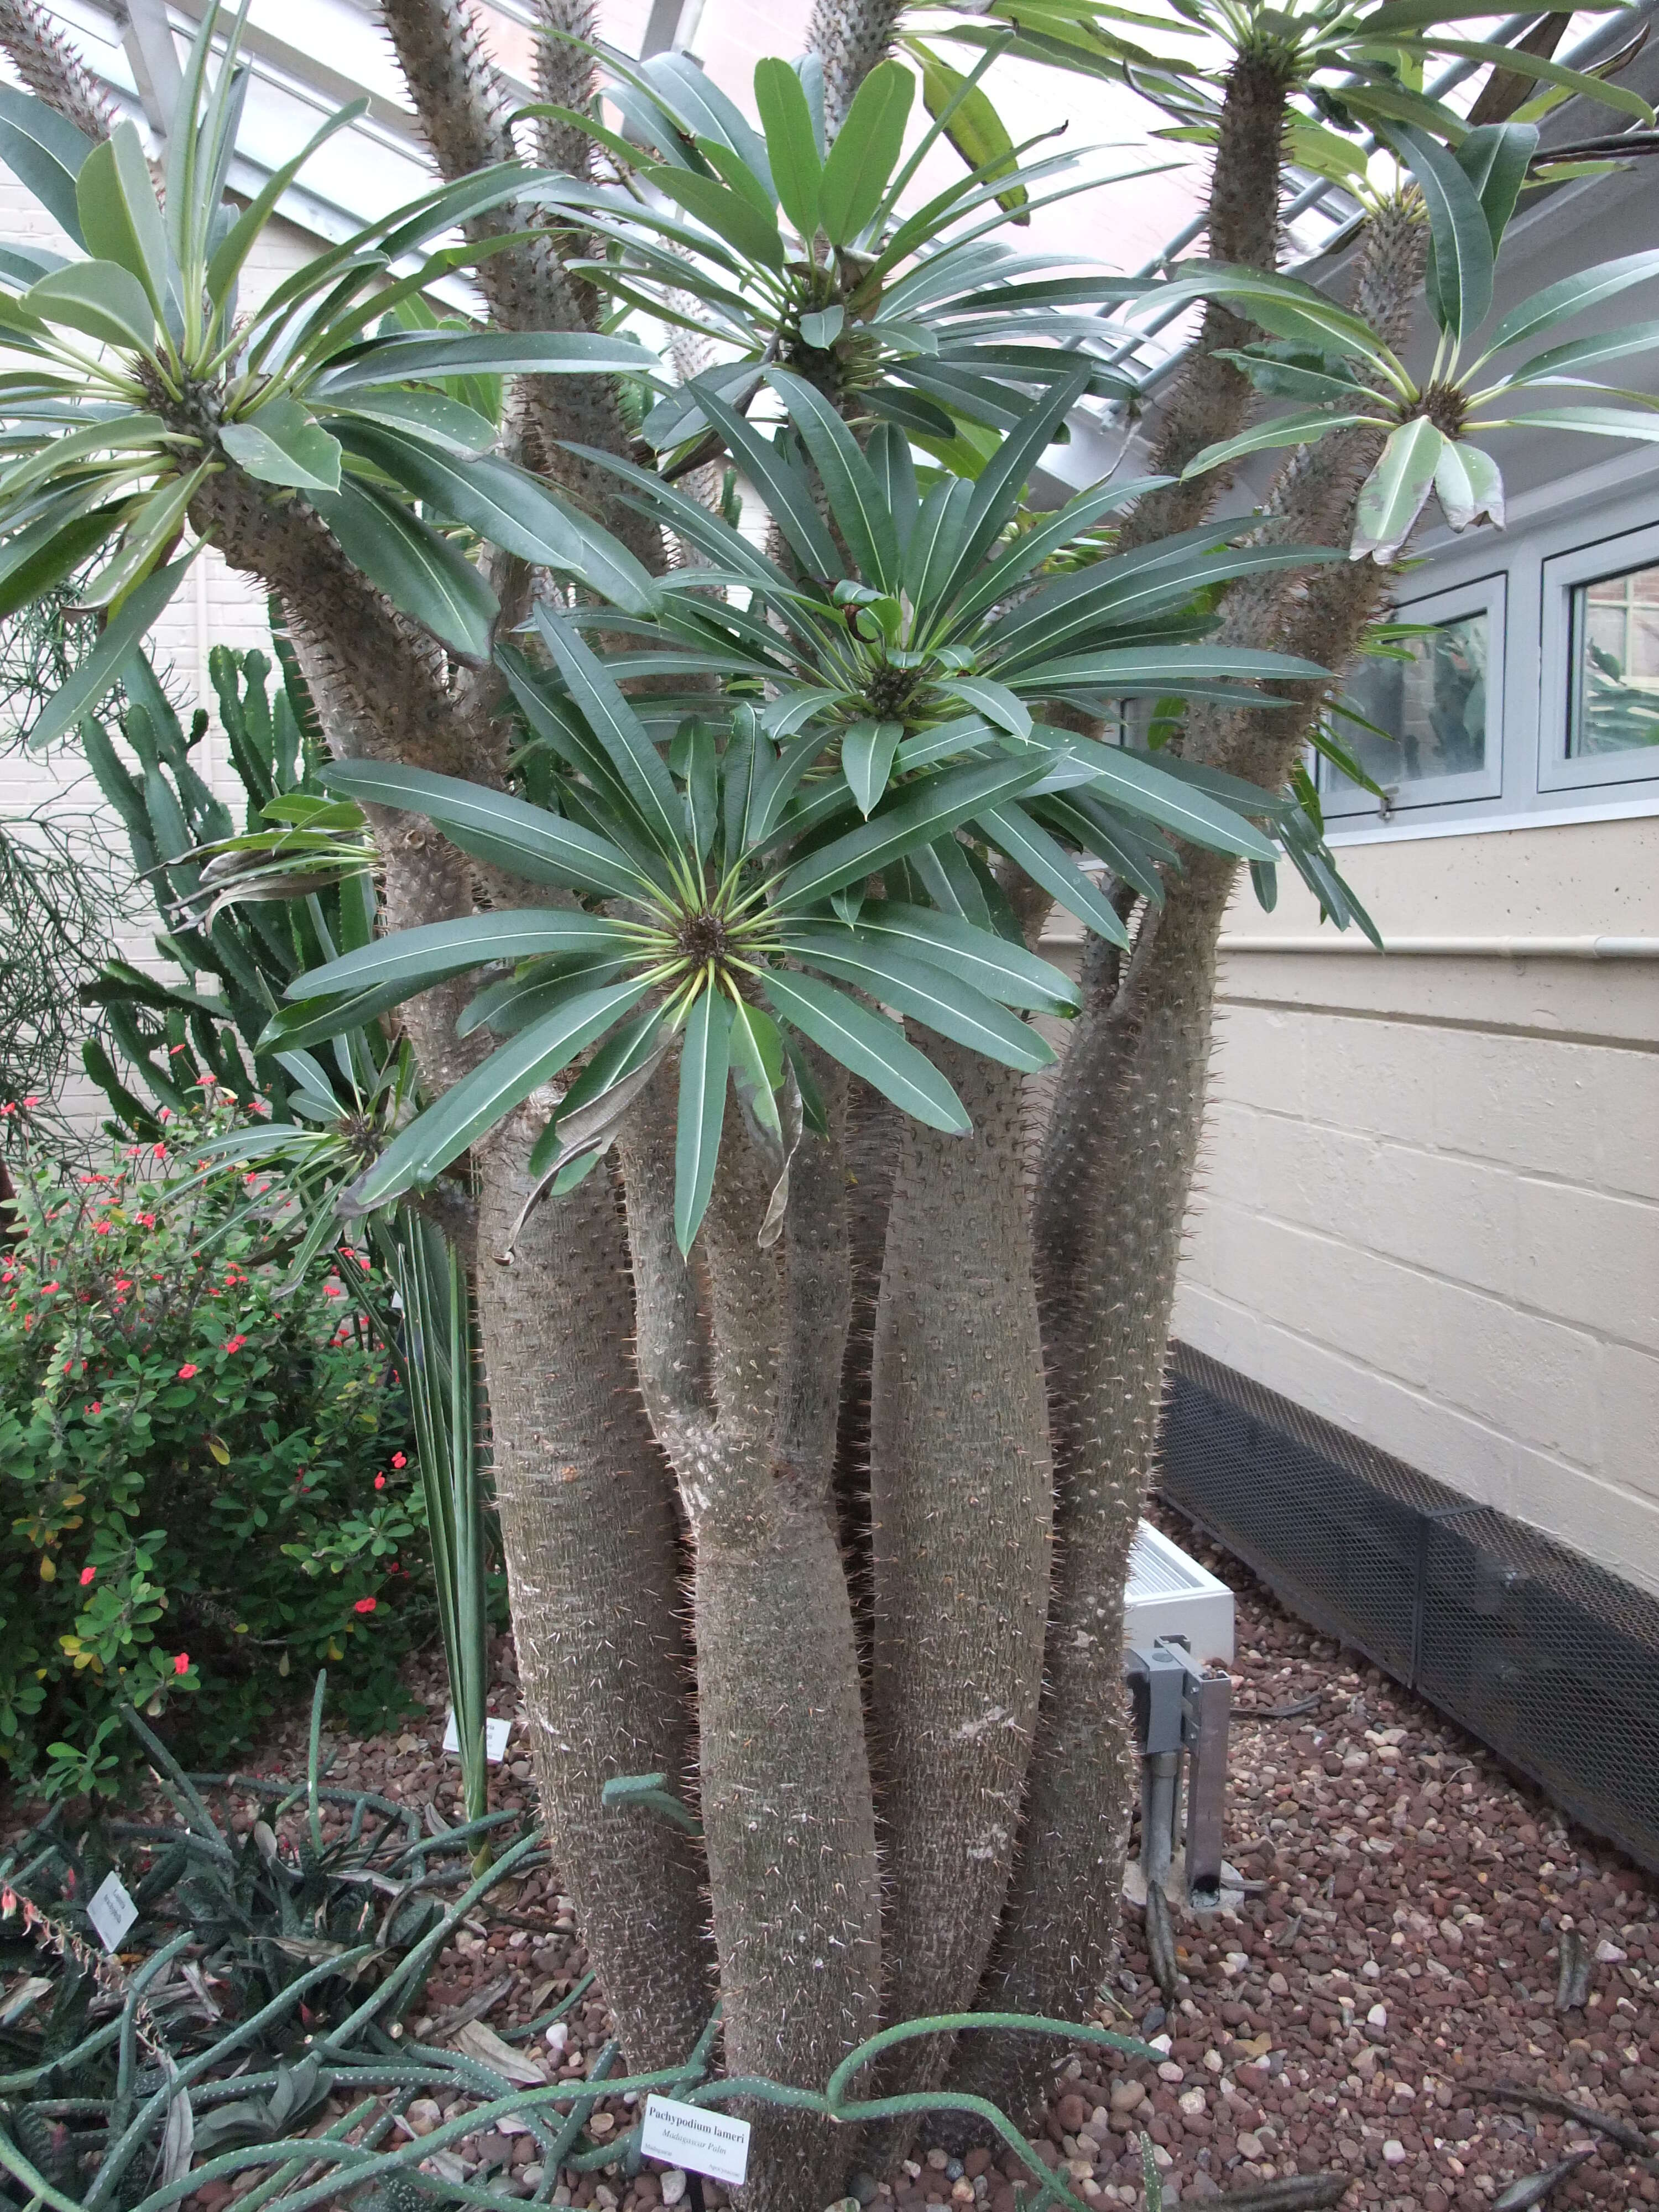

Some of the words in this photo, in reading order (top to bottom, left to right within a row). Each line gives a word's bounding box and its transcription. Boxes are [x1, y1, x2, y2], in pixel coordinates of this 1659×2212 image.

[649, 2106, 712, 2133] Pachypodium
[714, 2126, 745, 2143] lameri
[662, 2128, 706, 2148] Madagascar
[708, 2143, 727, 2154] Palm
